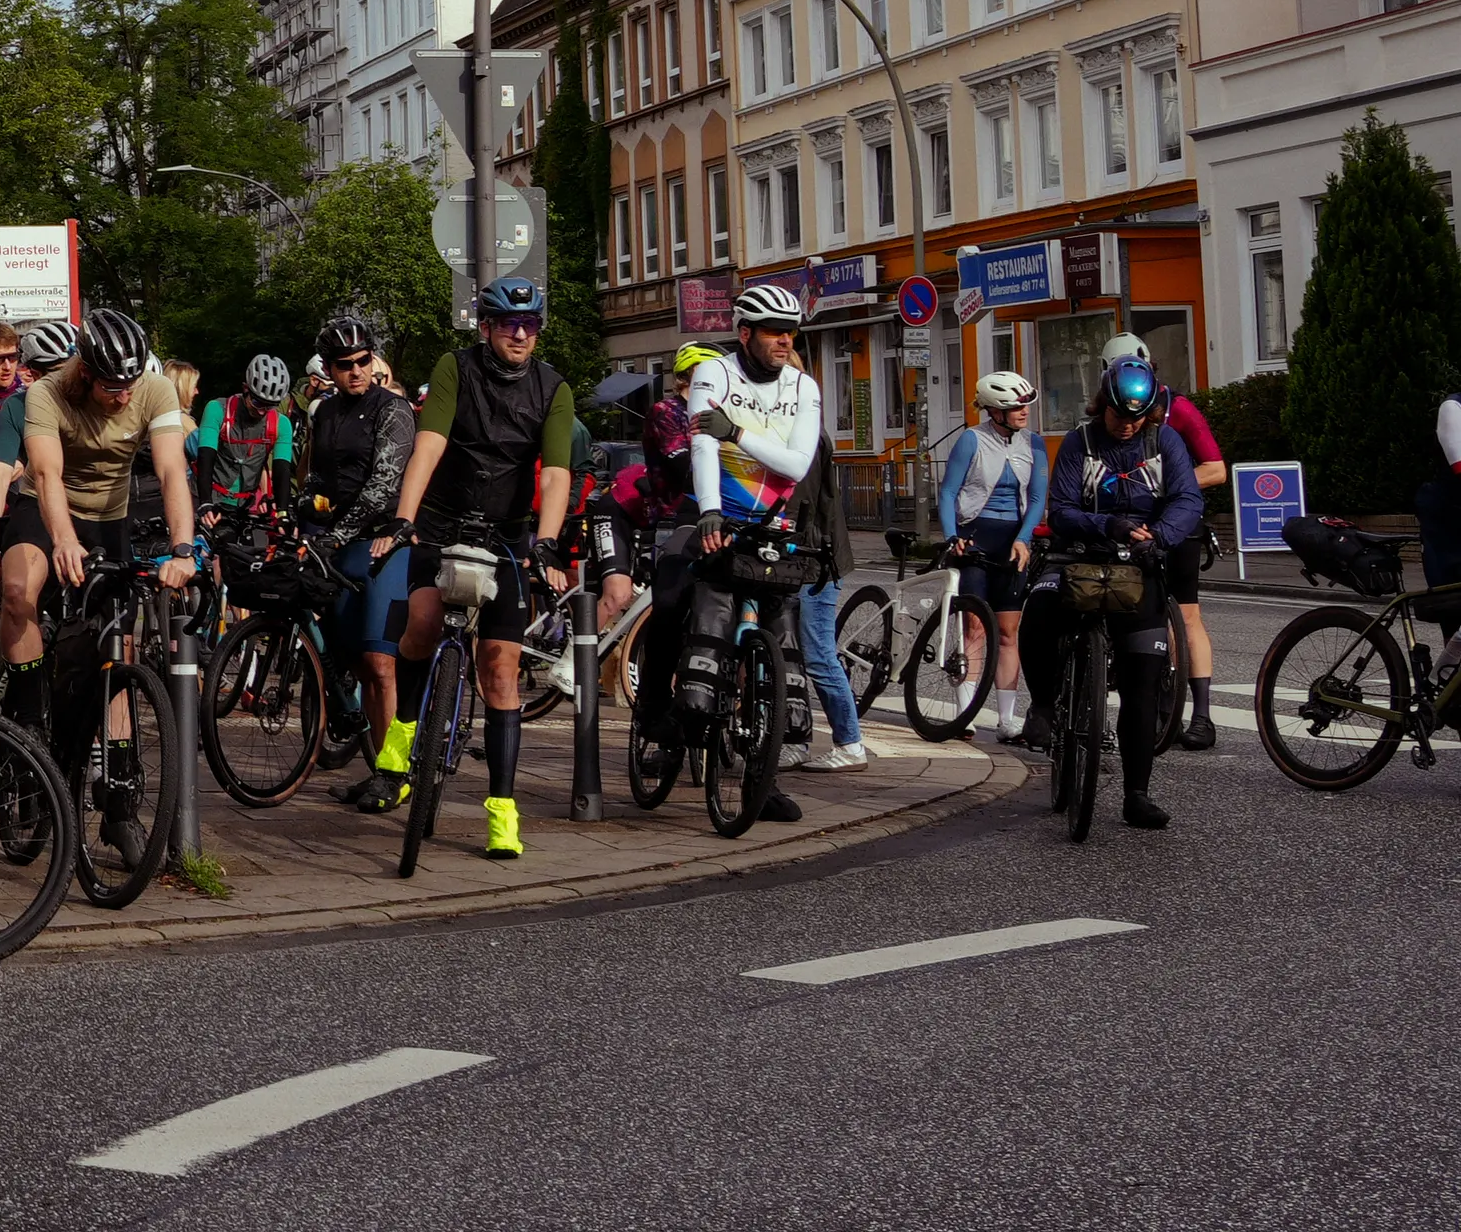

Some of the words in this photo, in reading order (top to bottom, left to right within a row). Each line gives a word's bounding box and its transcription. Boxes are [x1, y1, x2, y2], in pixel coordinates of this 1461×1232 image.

[4, 258, 49, 271] verlegt
[987, 254, 1044, 281] RESTAURANT
[598, 522, 612, 537] RG
